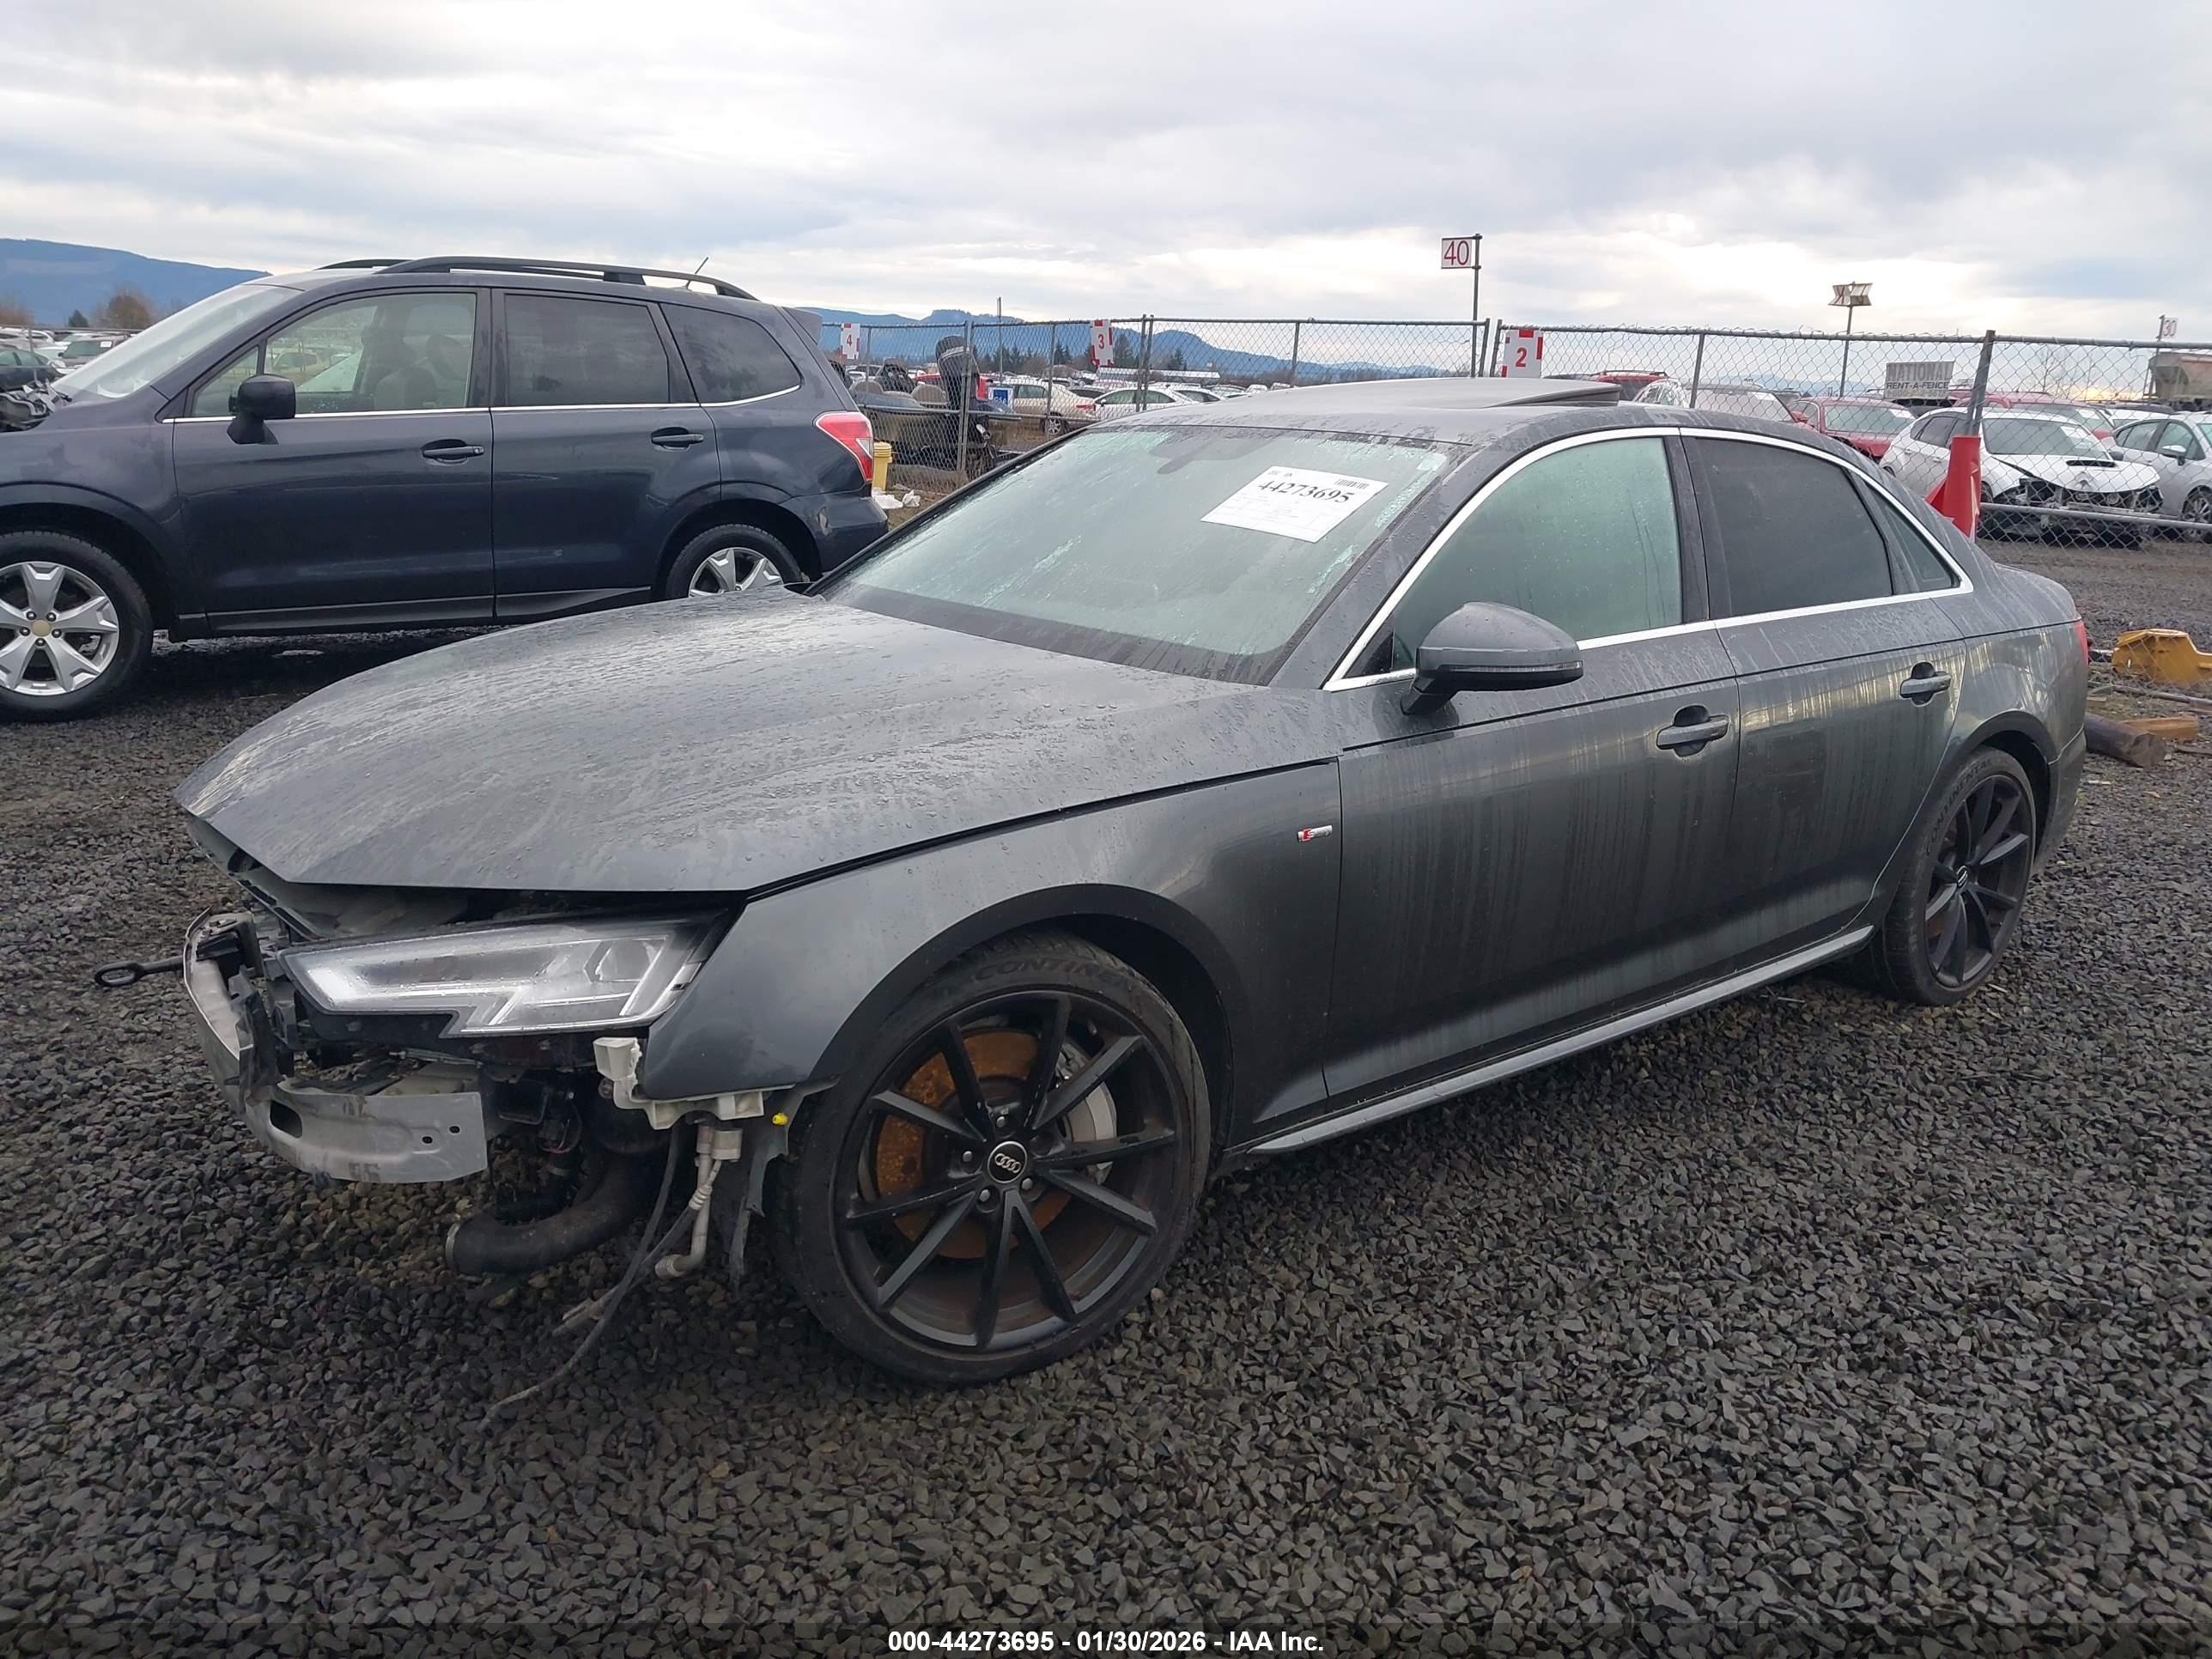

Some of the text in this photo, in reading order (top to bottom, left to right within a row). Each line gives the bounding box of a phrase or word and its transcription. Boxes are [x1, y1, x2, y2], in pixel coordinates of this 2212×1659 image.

[1443, 240, 1469, 266] 40
[846, 334, 853, 347] 4
[1098, 333, 1105, 349] 3
[1515, 347, 1528, 368] 2
[1887, 363, 1950, 380] NATIONAL
[1258, 480, 1355, 503] 44273695
